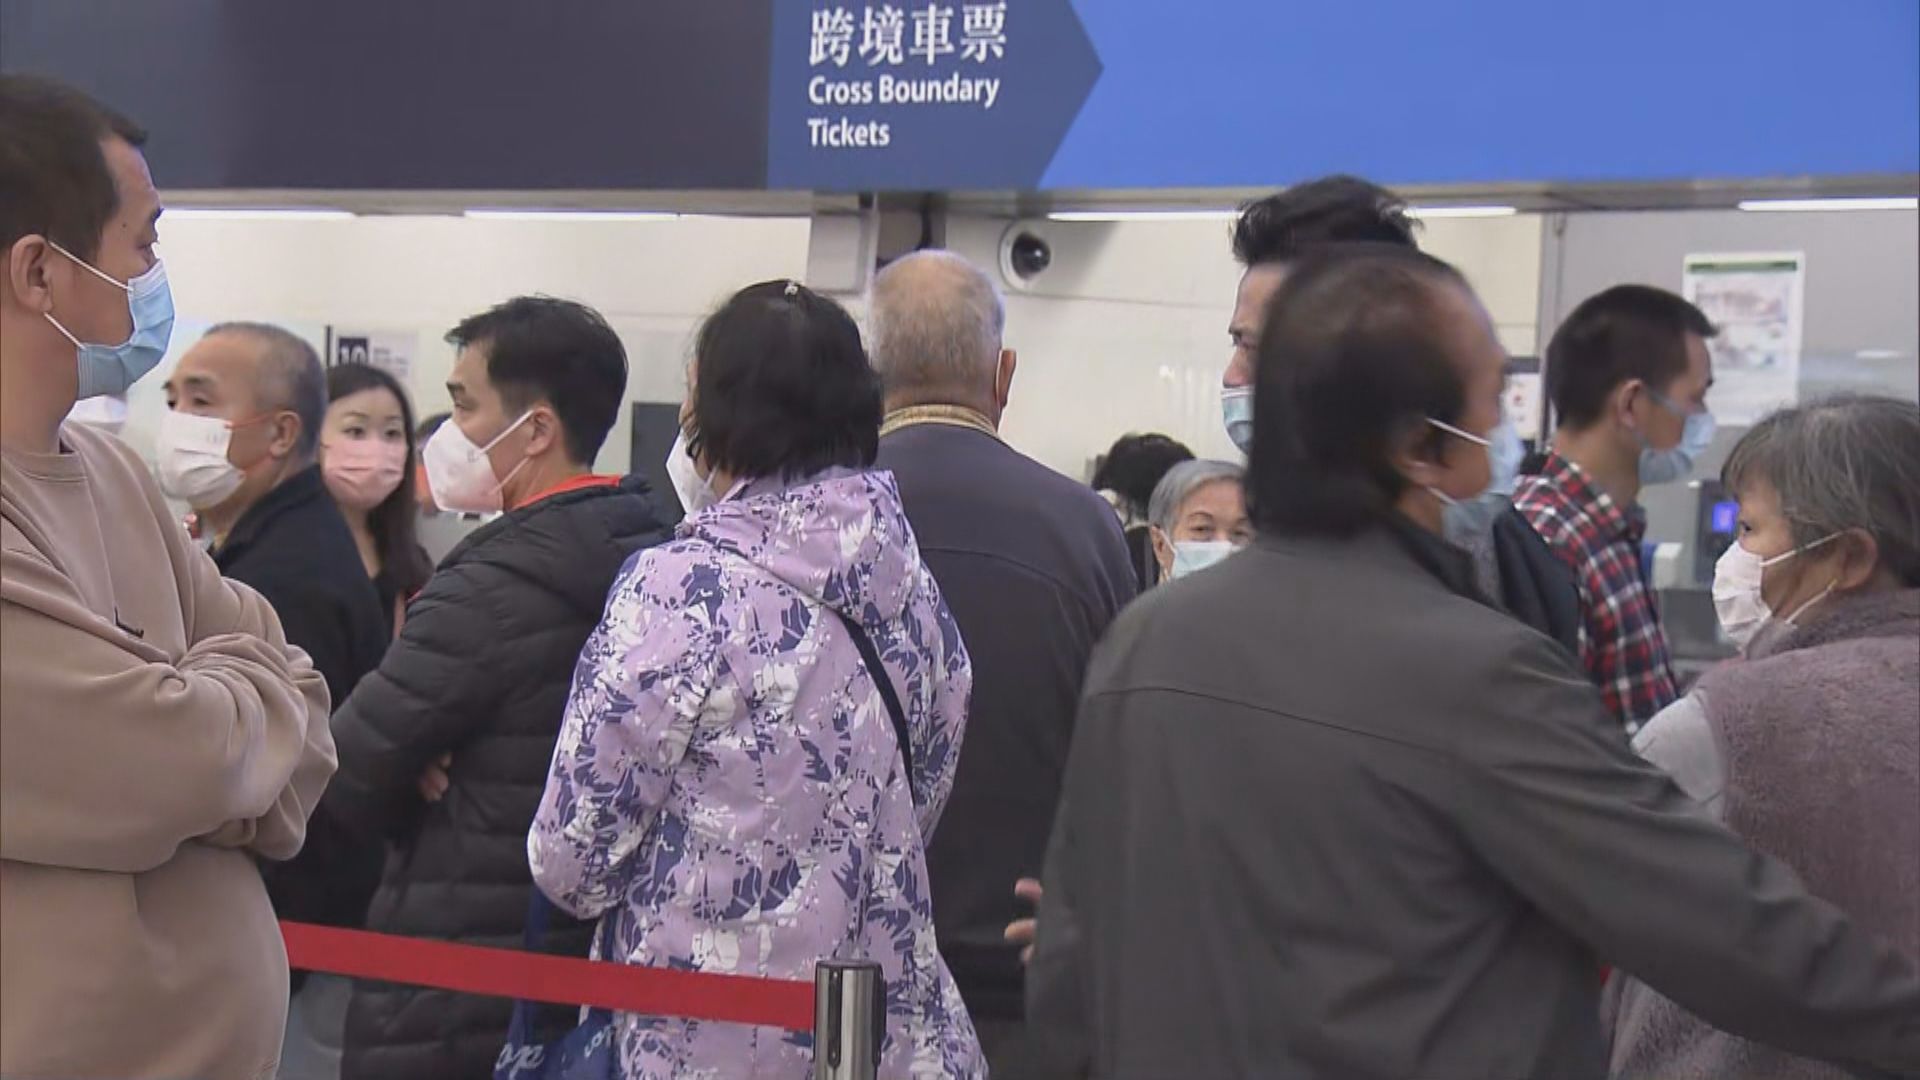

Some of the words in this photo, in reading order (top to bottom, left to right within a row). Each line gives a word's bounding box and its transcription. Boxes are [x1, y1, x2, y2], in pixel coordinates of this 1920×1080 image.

[809, 2, 1007, 66] 跨境車票
[808, 75, 873, 105] Cross
[879, 71, 1000, 109] Boundary
[808, 117, 891, 147] Tickets
